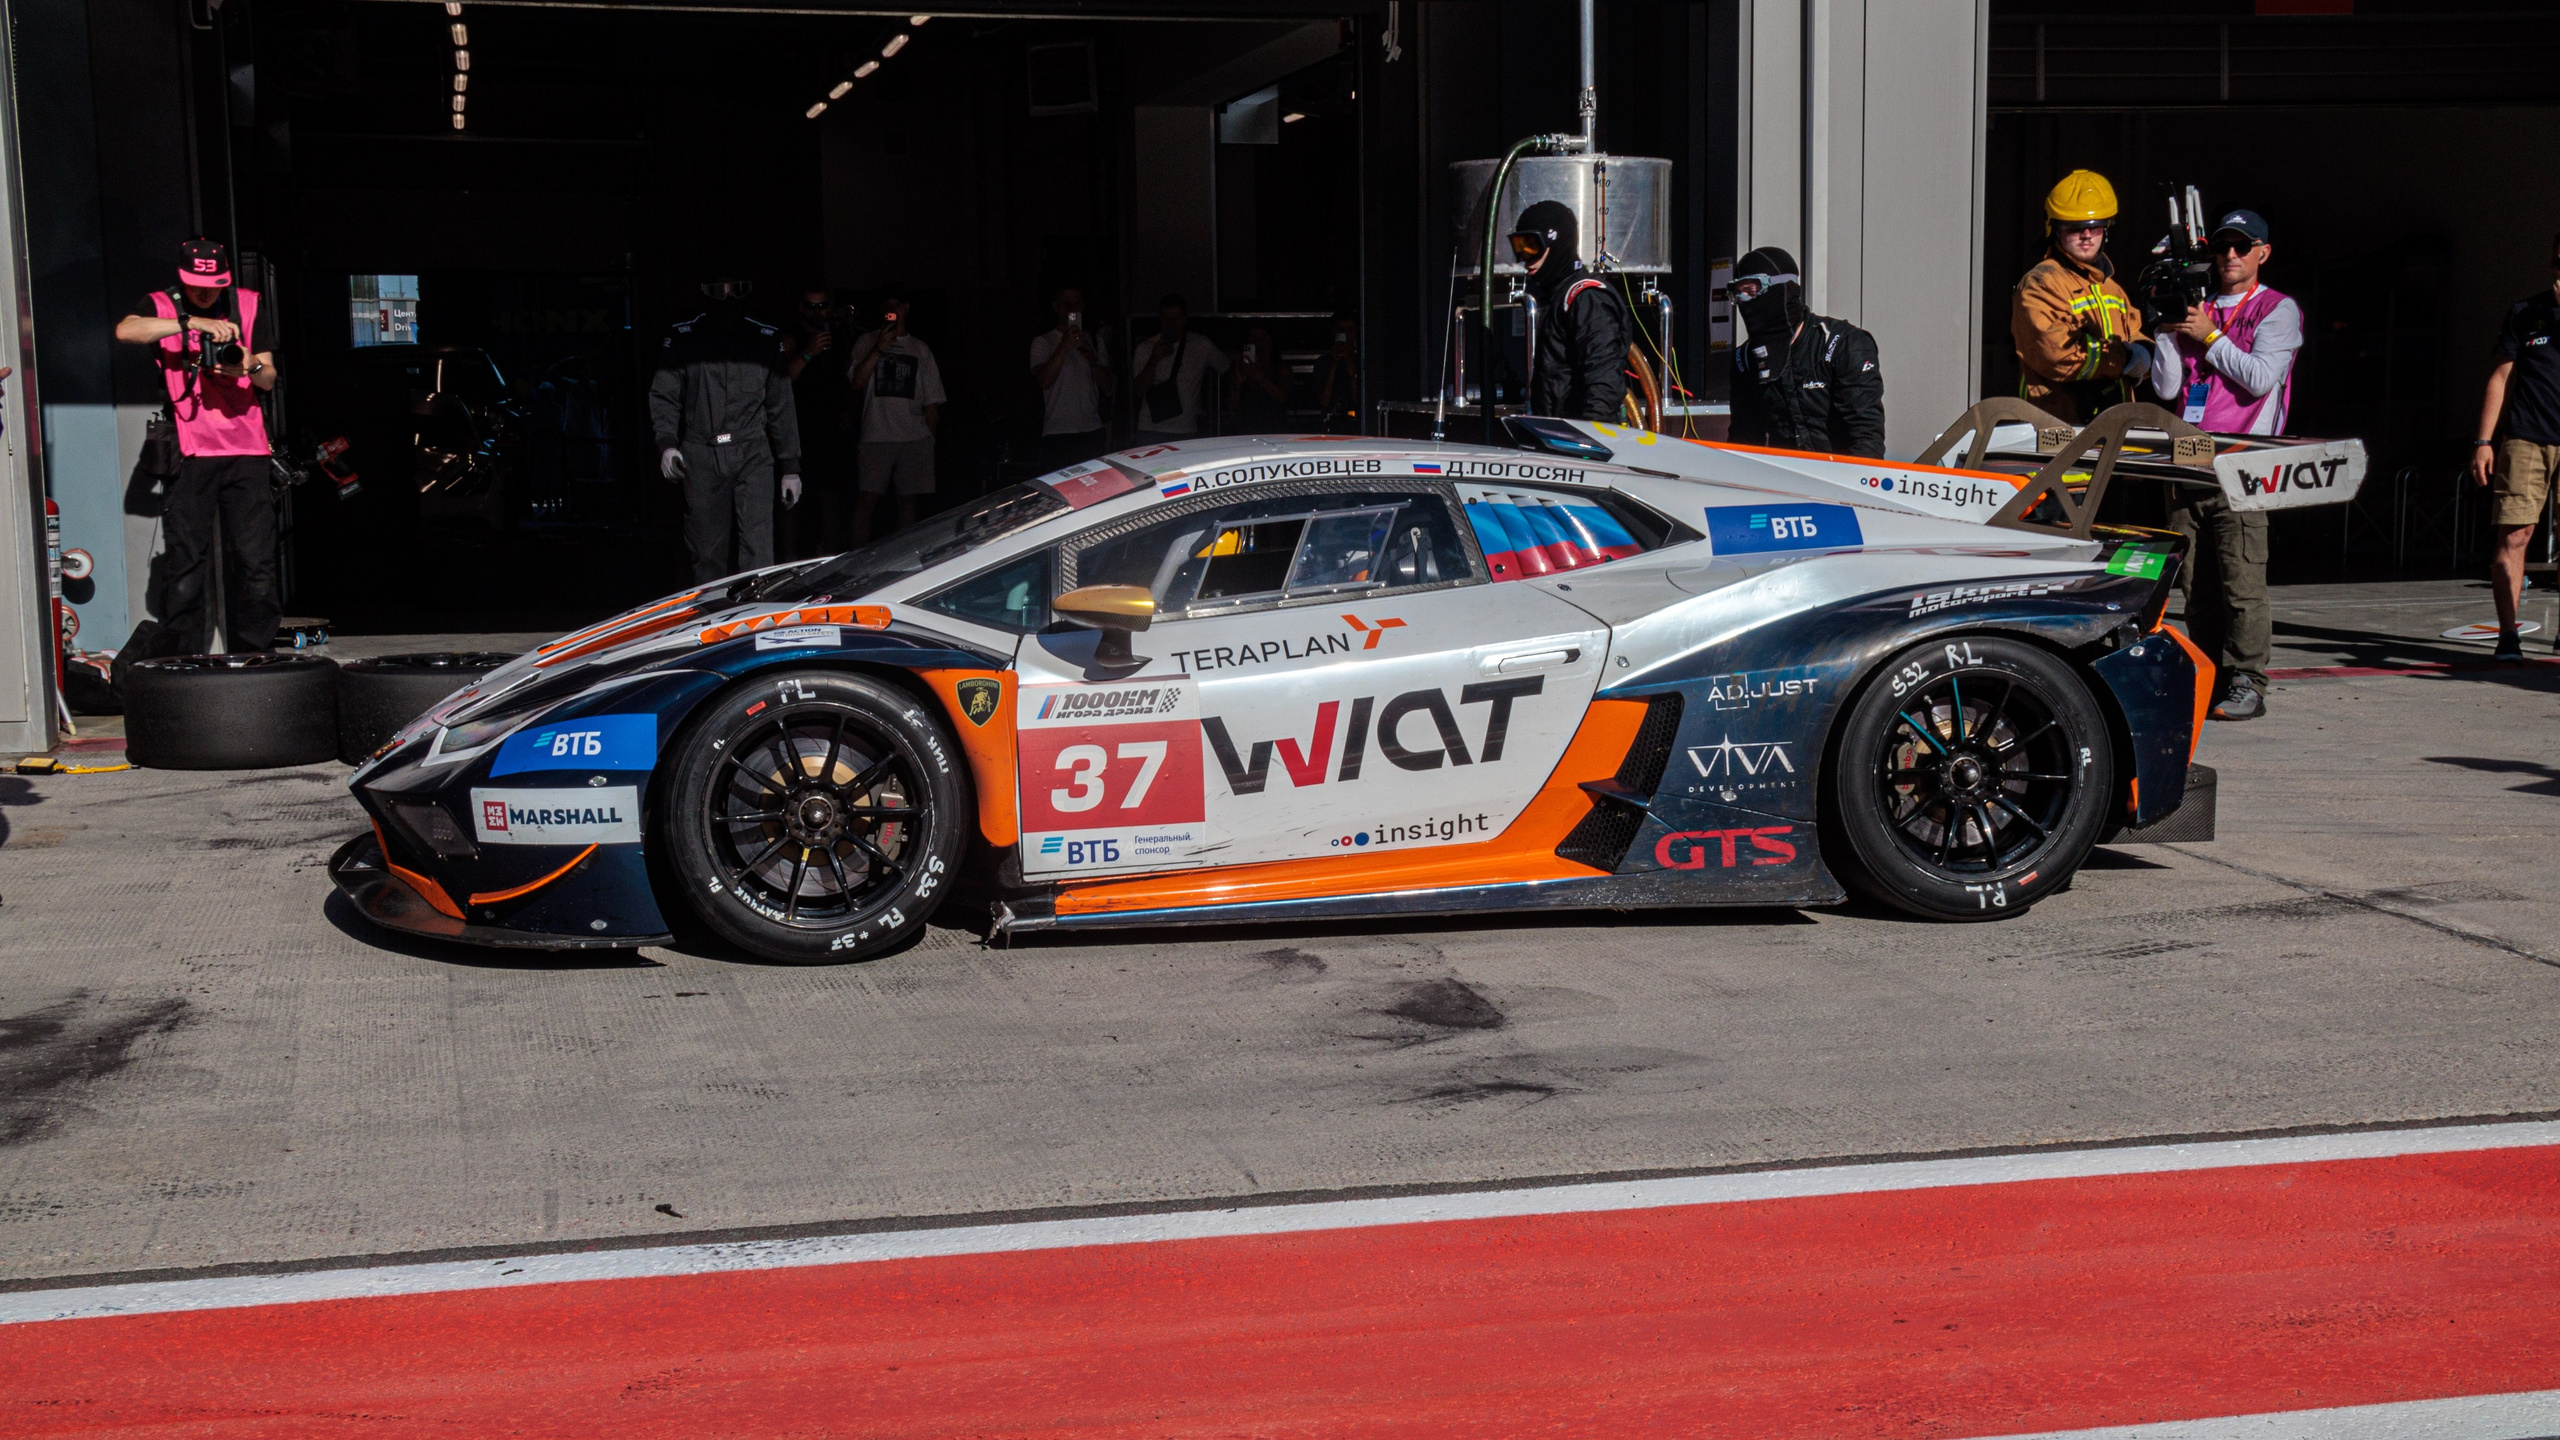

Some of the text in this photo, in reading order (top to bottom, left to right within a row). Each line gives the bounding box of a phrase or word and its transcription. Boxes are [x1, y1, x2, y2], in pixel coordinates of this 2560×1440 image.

[194, 258, 217, 272] 53
[1193, 460, 1382, 492] А.СОЛУКОВЦЕВ
[1446, 460, 1585, 483] Д.ПОГОСЯН
[1898, 475, 1998, 507] insight
[1771, 516, 1817, 539] ВТБ
[1908, 589, 2029, 619] motorsport
[1911, 584, 2030, 609] iskra
[1171, 633, 1350, 673] TERAPLAN
[1892, 641, 1983, 697] S32 RL
[959, 680, 999, 690] LAMBORGHINI
[1056, 709, 1102, 719] ИГОРА
[552, 731, 602, 756] ВТБ
[1200, 674, 1545, 796] WIAT
[1687, 735, 1796, 777] VIVA
[1051, 740, 1168, 813] 37
[1688, 781, 1797, 793] DEVELOPMENT
[509, 807, 622, 825] MARSHALL
[1375, 812, 1489, 845] insight
[1134, 832, 1191, 844] Генеральный
[1134, 845, 1170, 856] спонсор
[1655, 825, 1796, 870] GTS
[1067, 838, 1120, 864] ВТБ
[915, 855, 945, 899] S32
[878, 907, 905, 930] FL
